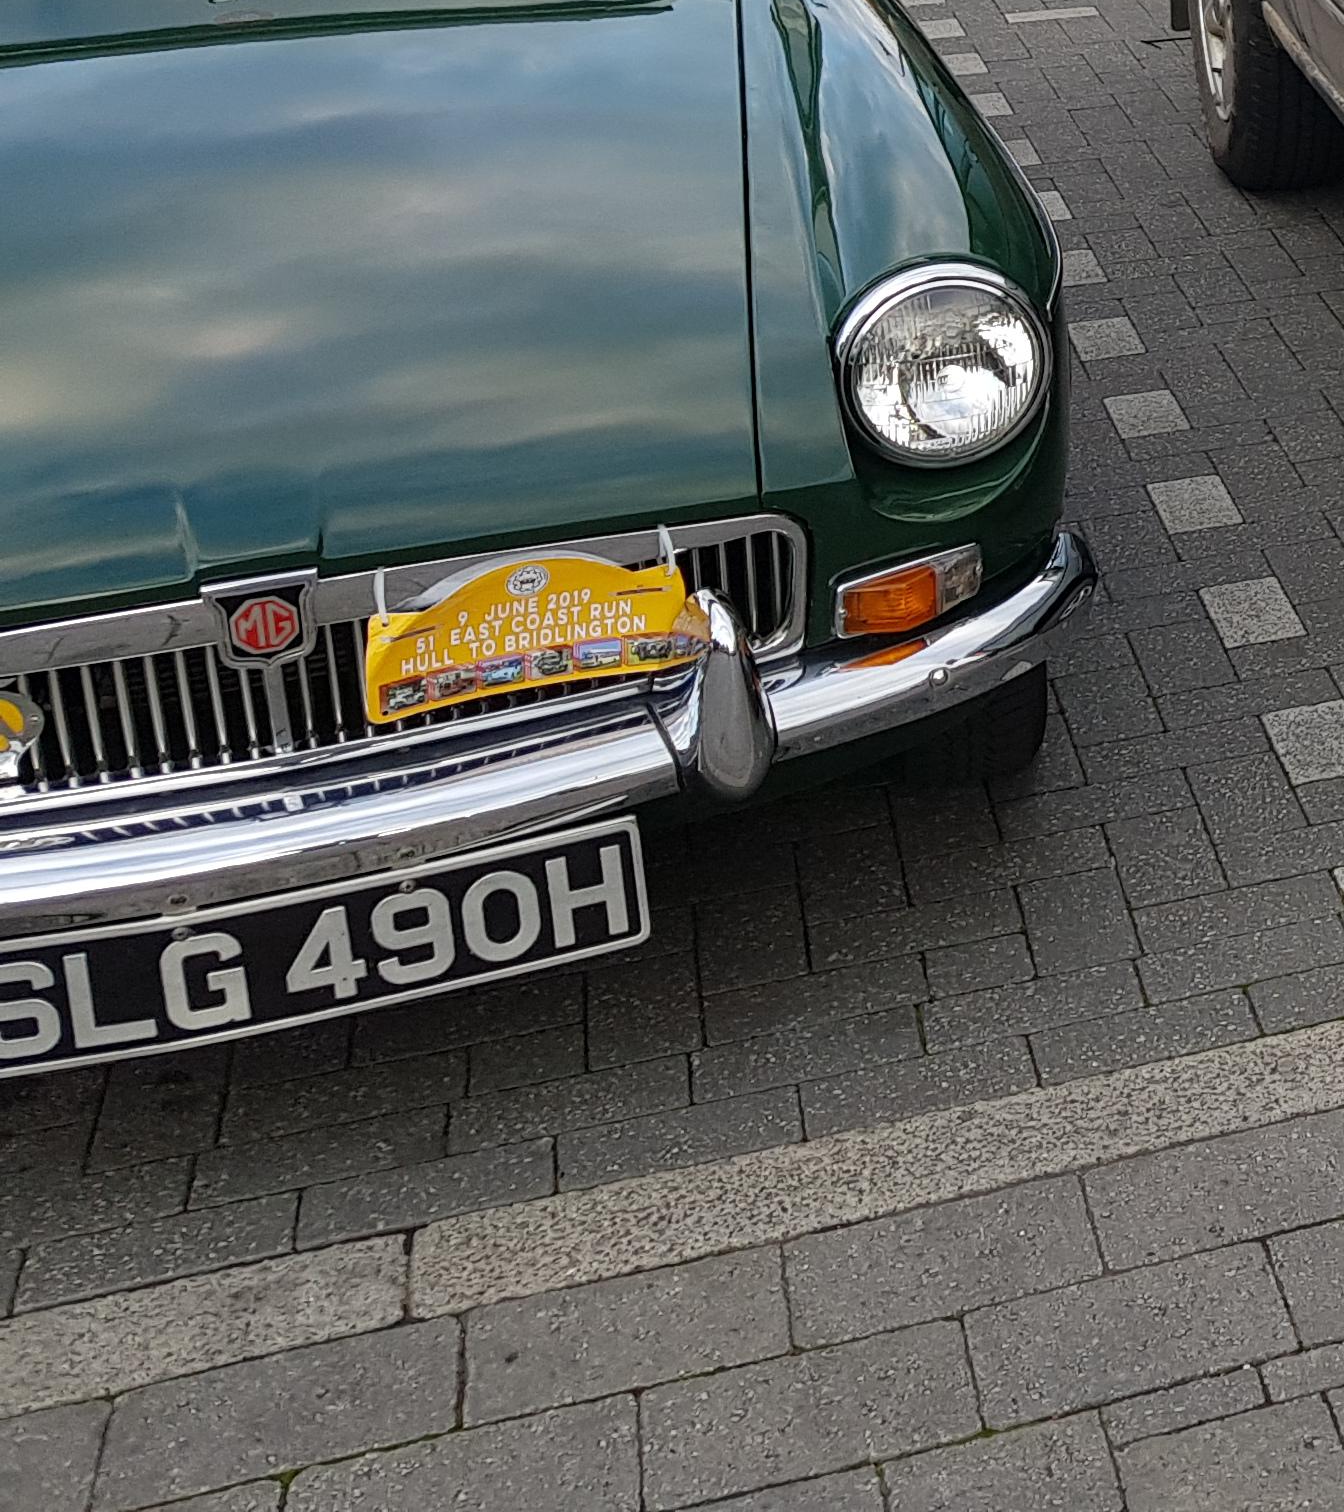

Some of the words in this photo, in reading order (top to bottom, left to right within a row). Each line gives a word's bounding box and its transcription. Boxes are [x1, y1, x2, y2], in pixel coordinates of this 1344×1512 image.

[236, 602, 294, 647] MG
[416, 635, 436, 654] 51
[450, 620, 503, 647] EAST
[512, 606, 582, 632] COAST
[590, 599, 632, 620] RUN
[458, 611, 469, 627] 9
[485, 597, 539, 620] JUNE
[547, 589, 591, 610] 2019
[401, 650, 454, 676] HULL
[470, 640, 496, 659] TO
[505, 615, 647, 653] BRIDLINGTON
[0, 932, 253, 1060] SLG
[286, 844, 630, 1000] 490H
